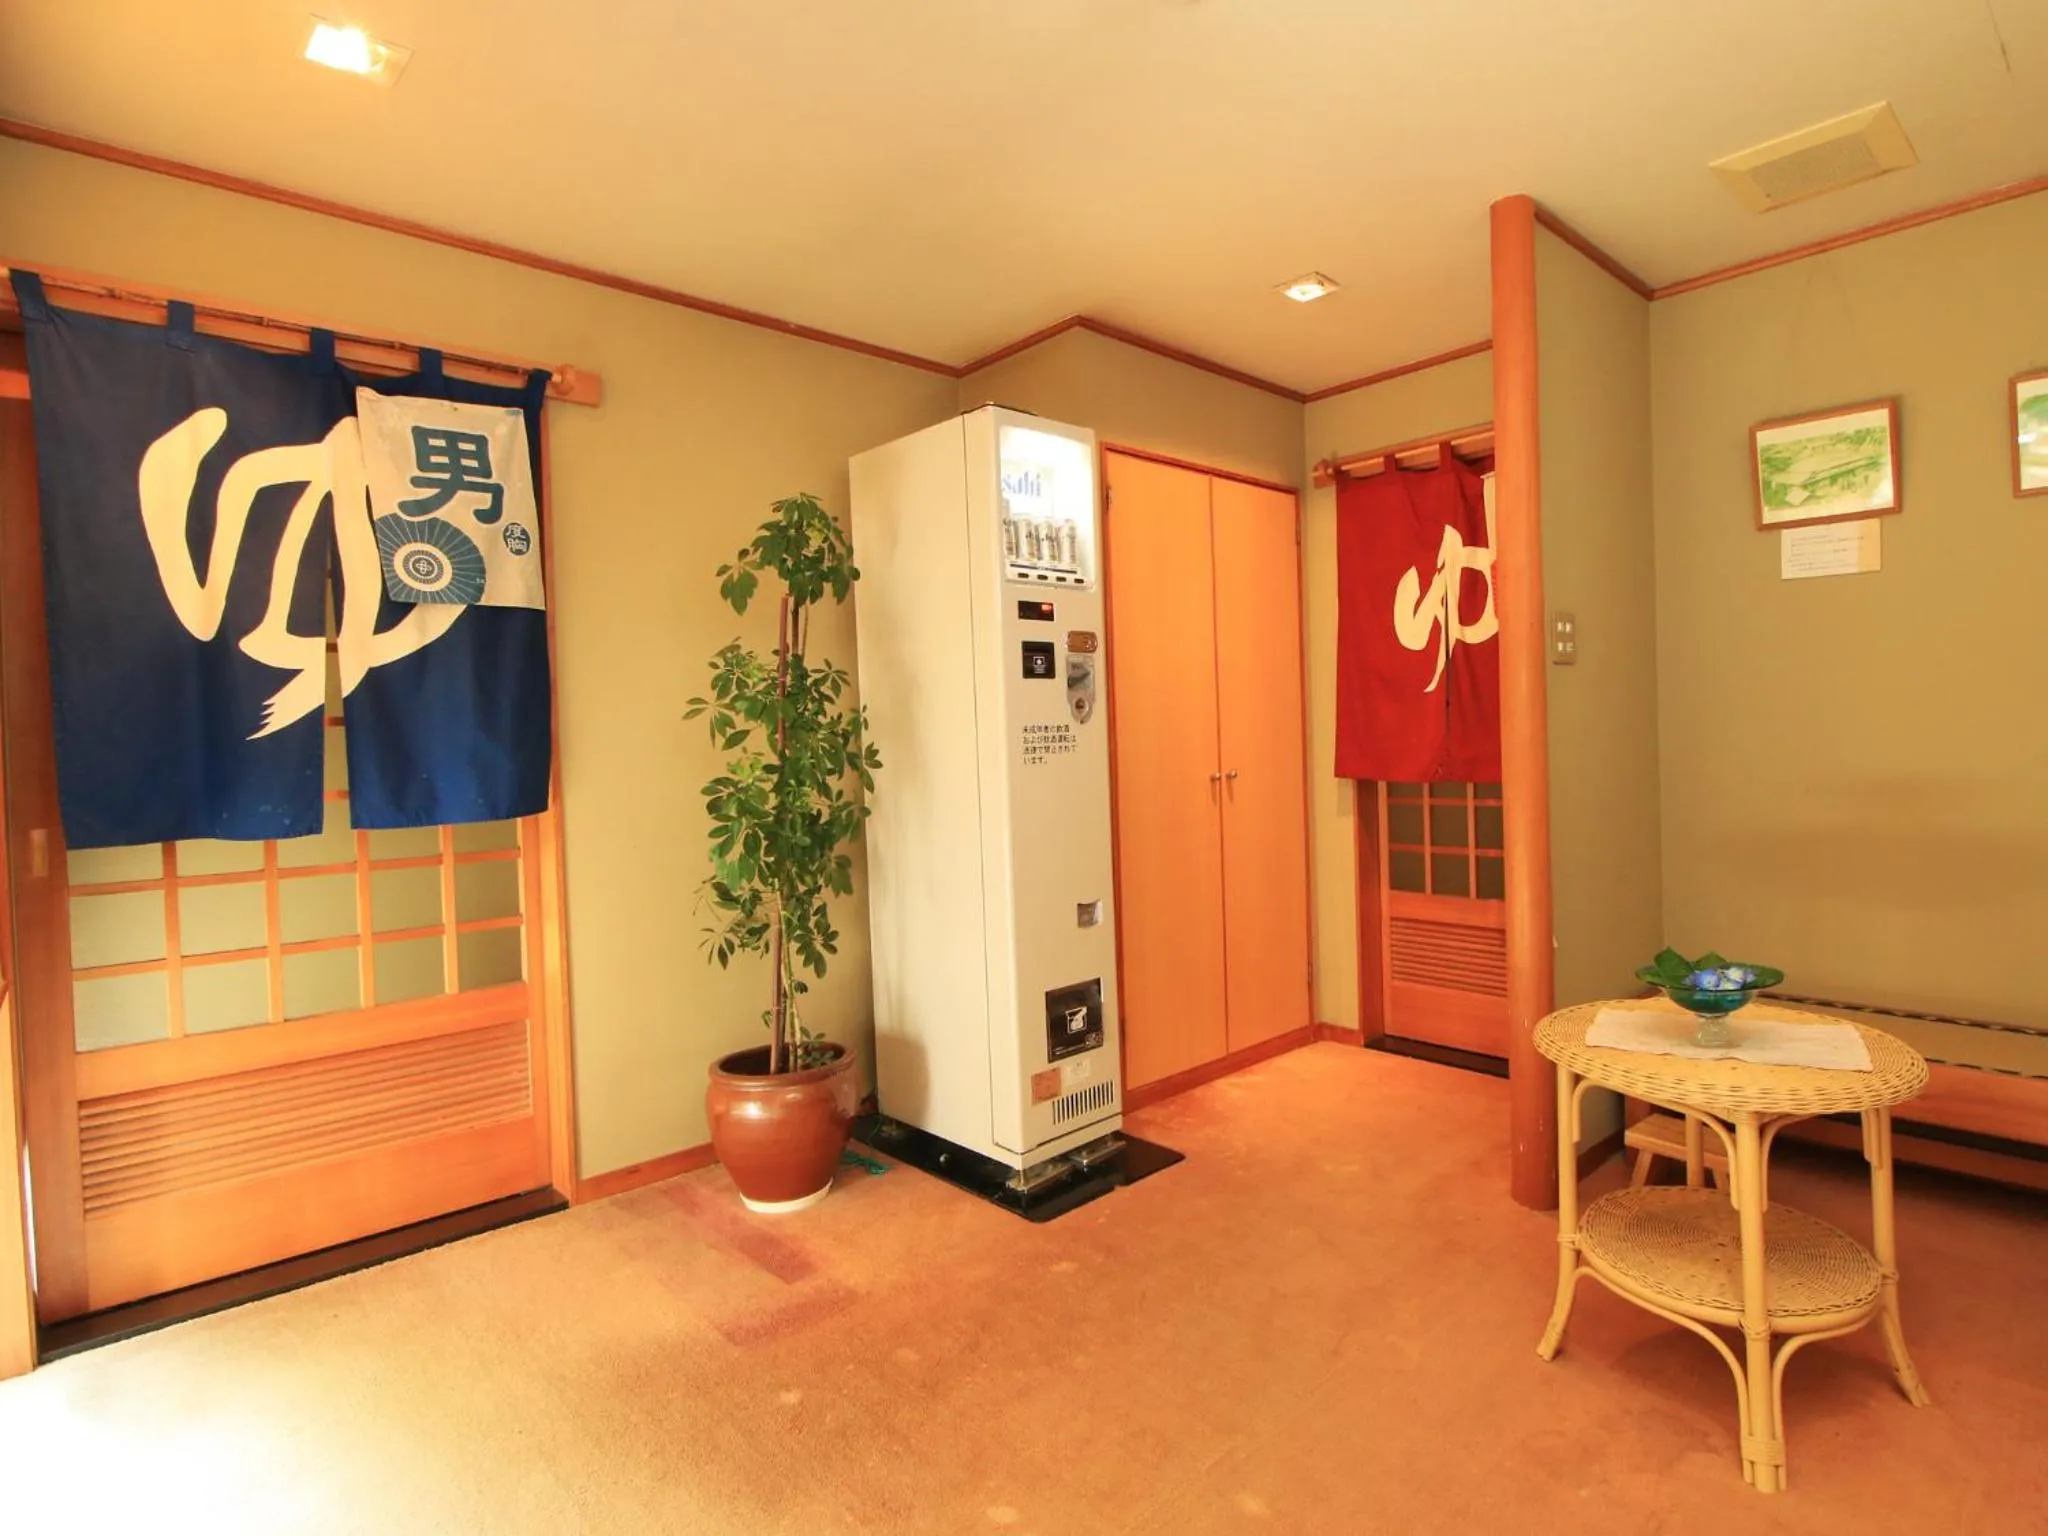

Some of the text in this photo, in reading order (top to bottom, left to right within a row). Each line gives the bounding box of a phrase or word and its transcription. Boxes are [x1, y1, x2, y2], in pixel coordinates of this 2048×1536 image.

[397, 425, 504, 525] 男
[1002, 471, 1041, 497] sahi
[139, 407, 468, 741] ゆ
[1393, 524, 1499, 692] ゆ
